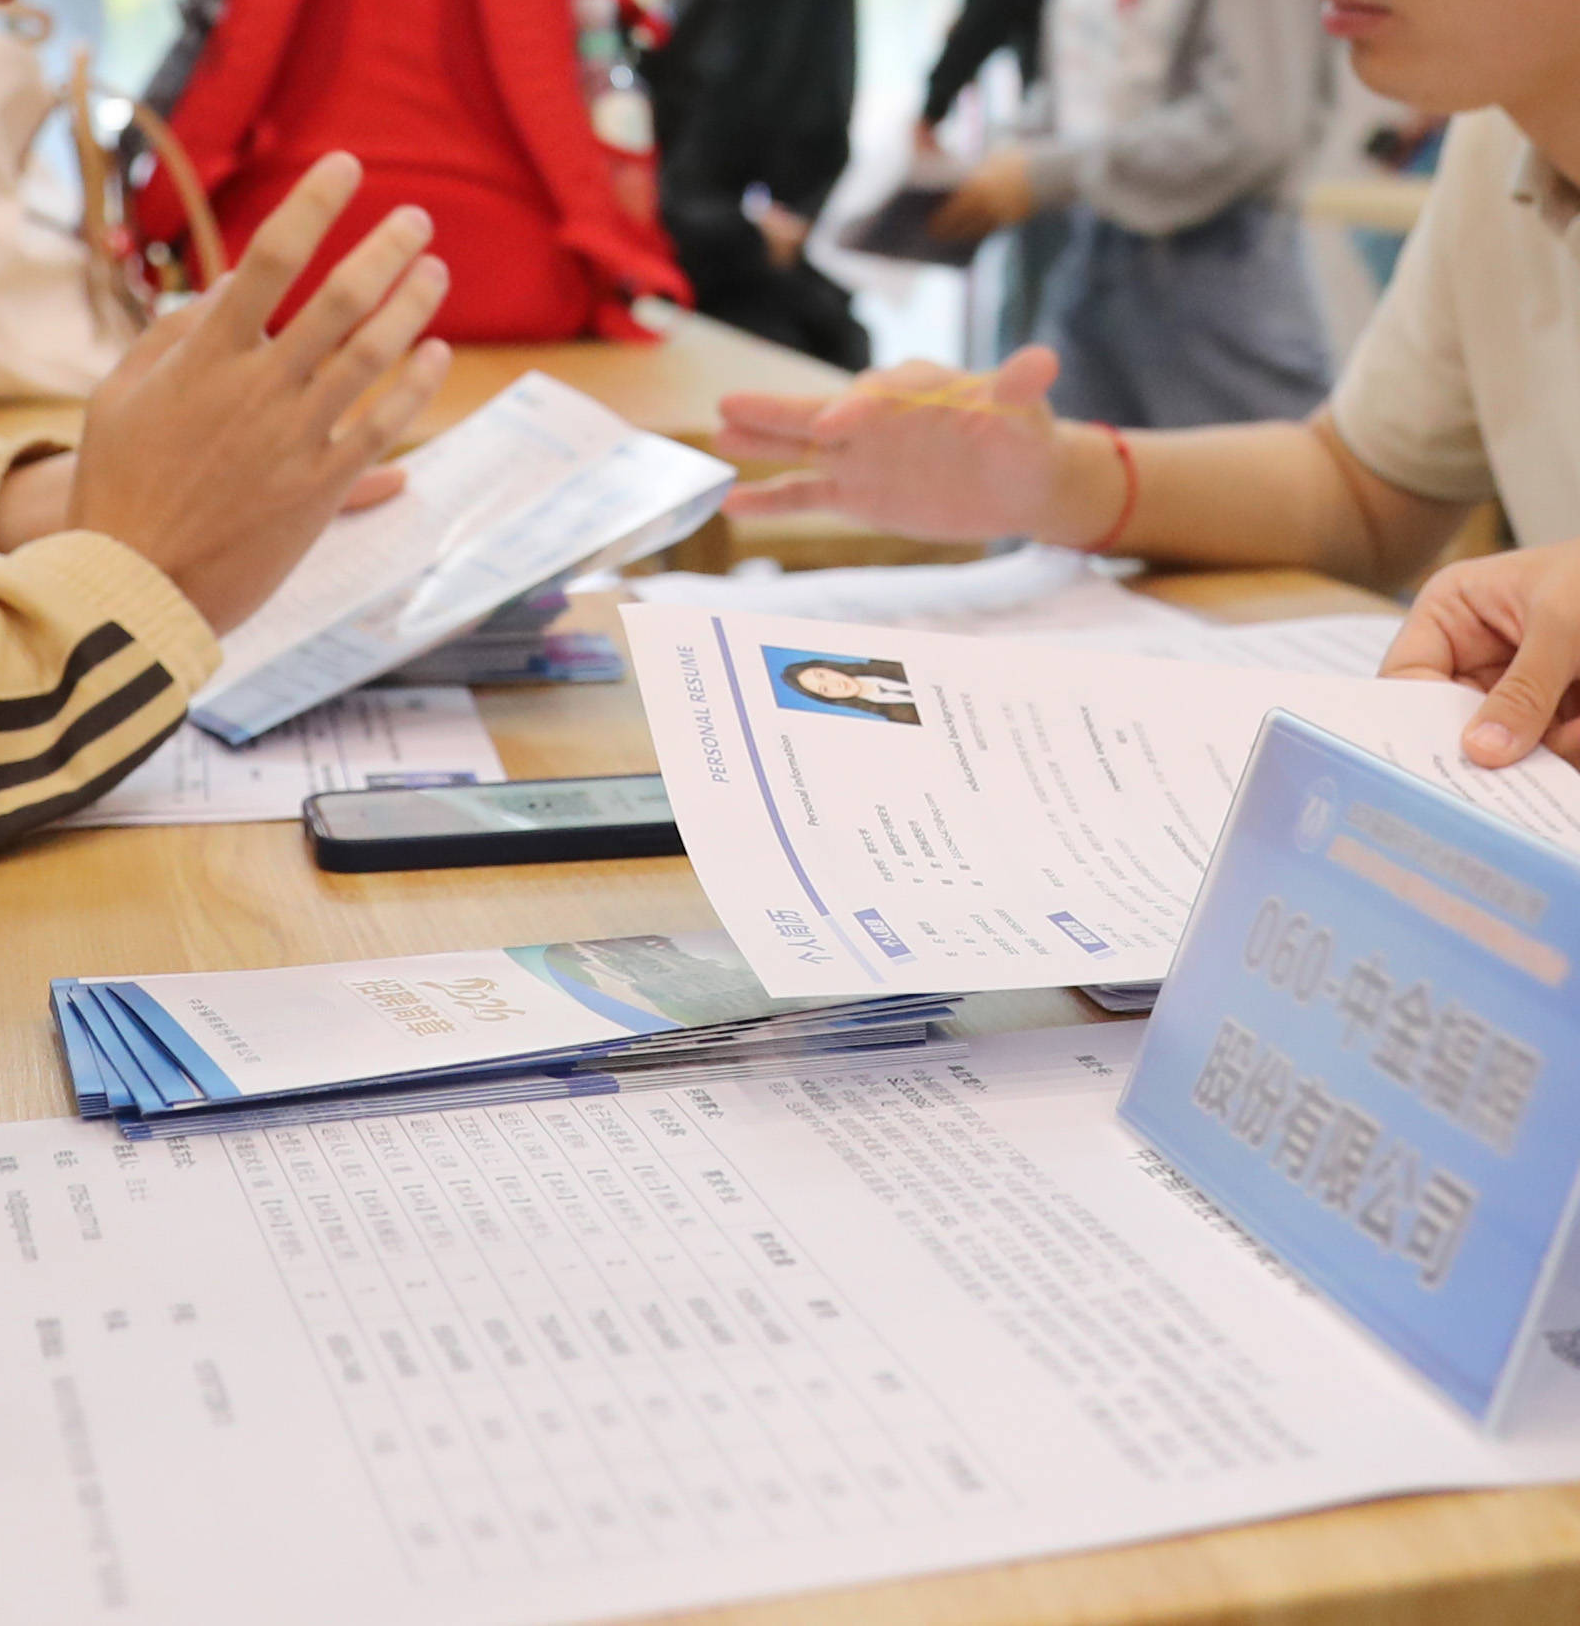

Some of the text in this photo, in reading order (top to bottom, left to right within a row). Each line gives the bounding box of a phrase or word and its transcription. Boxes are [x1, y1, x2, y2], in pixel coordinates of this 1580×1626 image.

[676, 645, 729, 782] PERSONAL RESUME
[795, 789, 820, 826] Personal
[765, 908, 833, 965] 个人简历
[351, 977, 457, 1037] 招聘简章
[423, 976, 526, 1022] 2026
[1191, 1015, 1482, 1292] 股份有限公司
